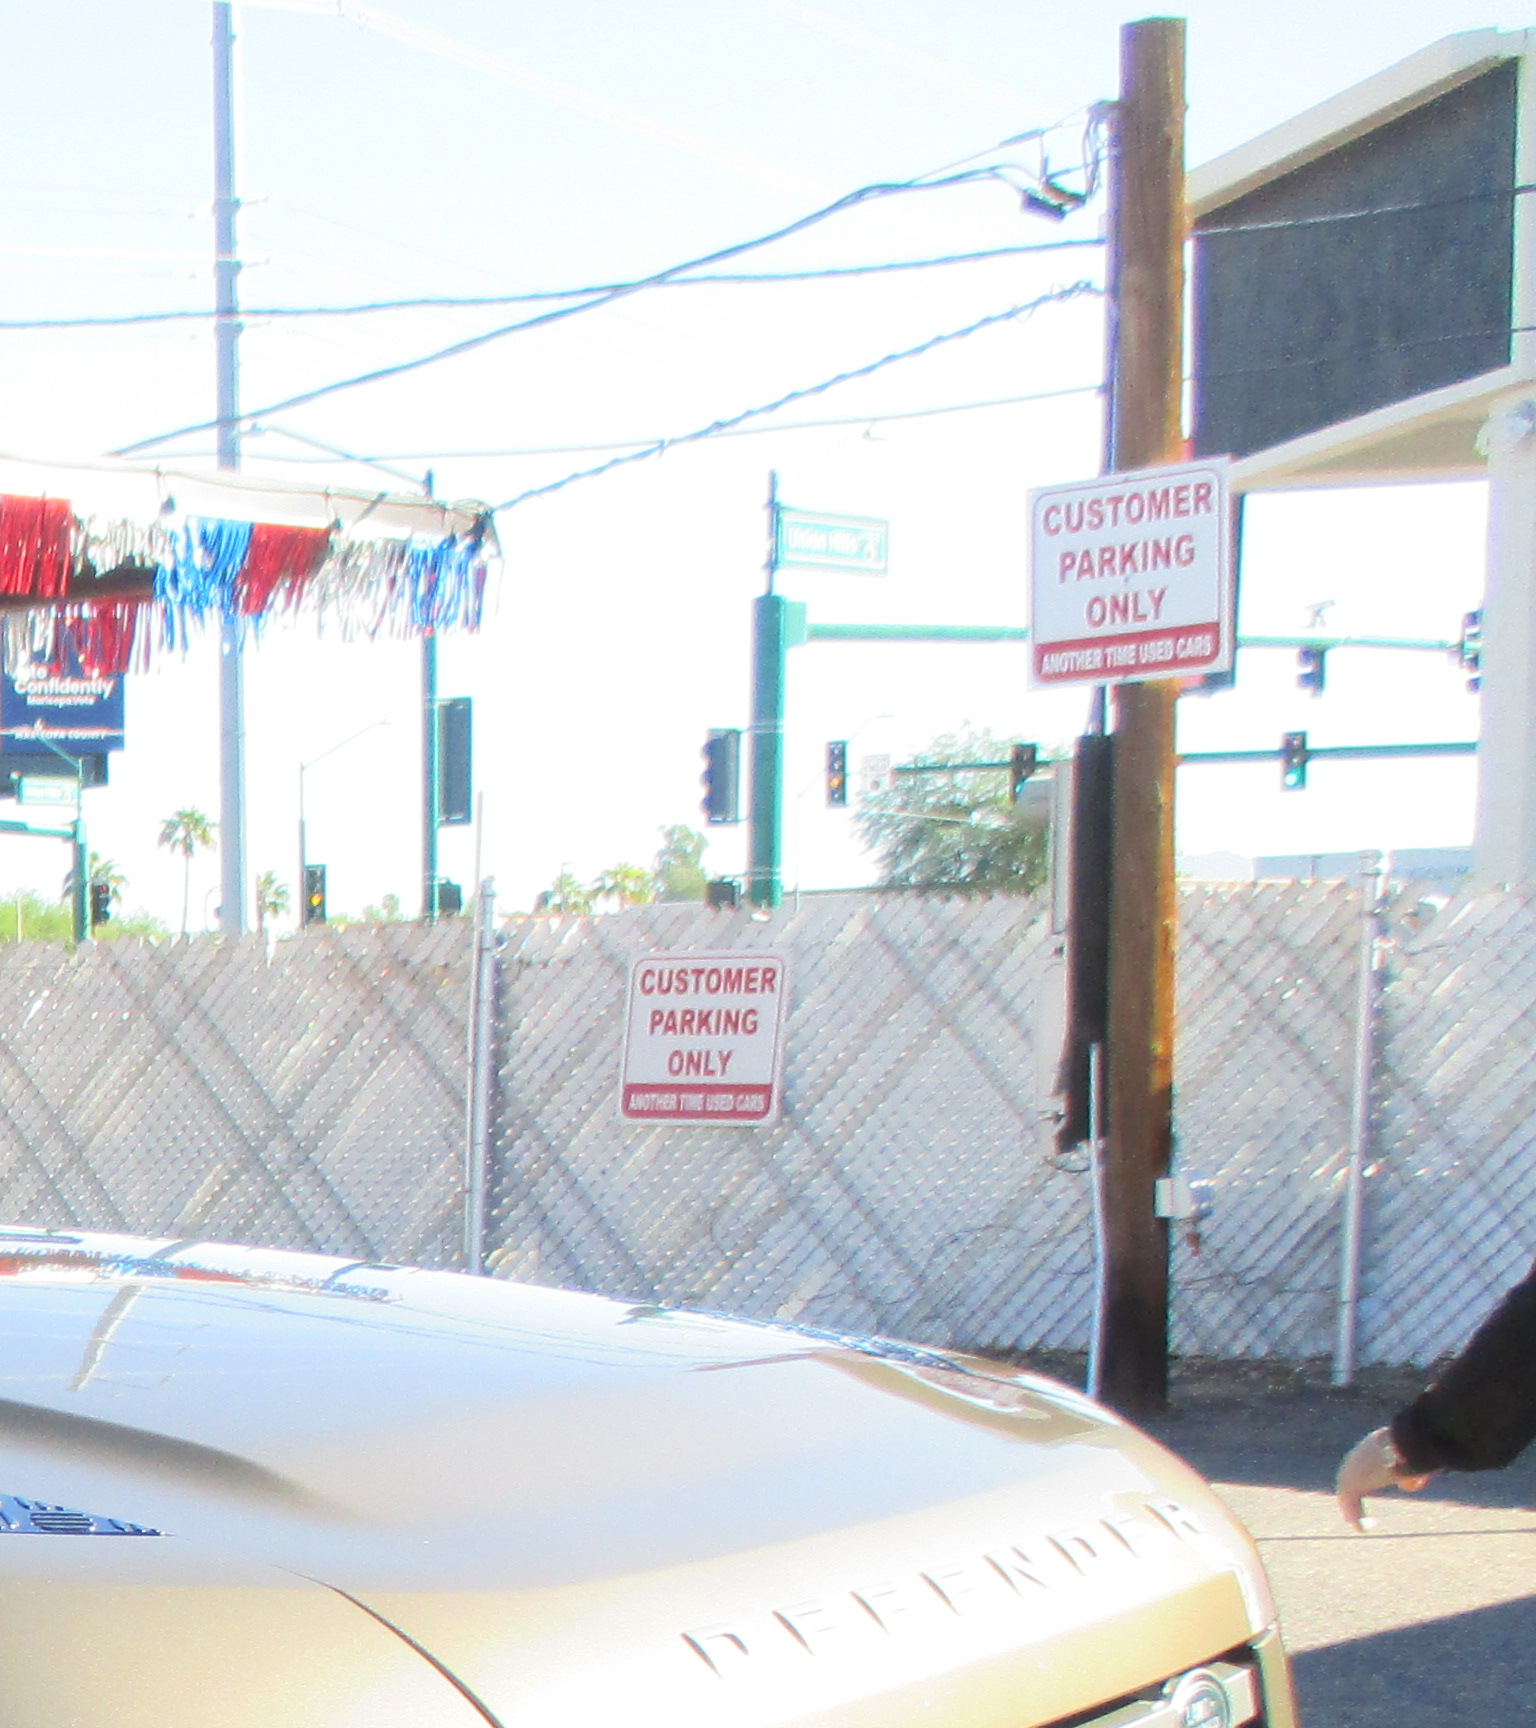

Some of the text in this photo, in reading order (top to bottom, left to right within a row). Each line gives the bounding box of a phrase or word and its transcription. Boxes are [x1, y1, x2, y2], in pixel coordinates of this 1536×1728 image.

[1042, 482, 1213, 537] CUSTOMER
[1058, 533, 1195, 584] PARKING
[1085, 586, 1167, 629] ONLY
[1041, 635, 1212, 674] ANOTHER TIME USED CARS
[14, 676, 116, 701] Confidently
[639, 967, 777, 996] CUSTOMER
[649, 1008, 759, 1036] PARKING
[667, 1049, 733, 1077] ONLY
[680, 1500, 1206, 1680] DEFENDER
